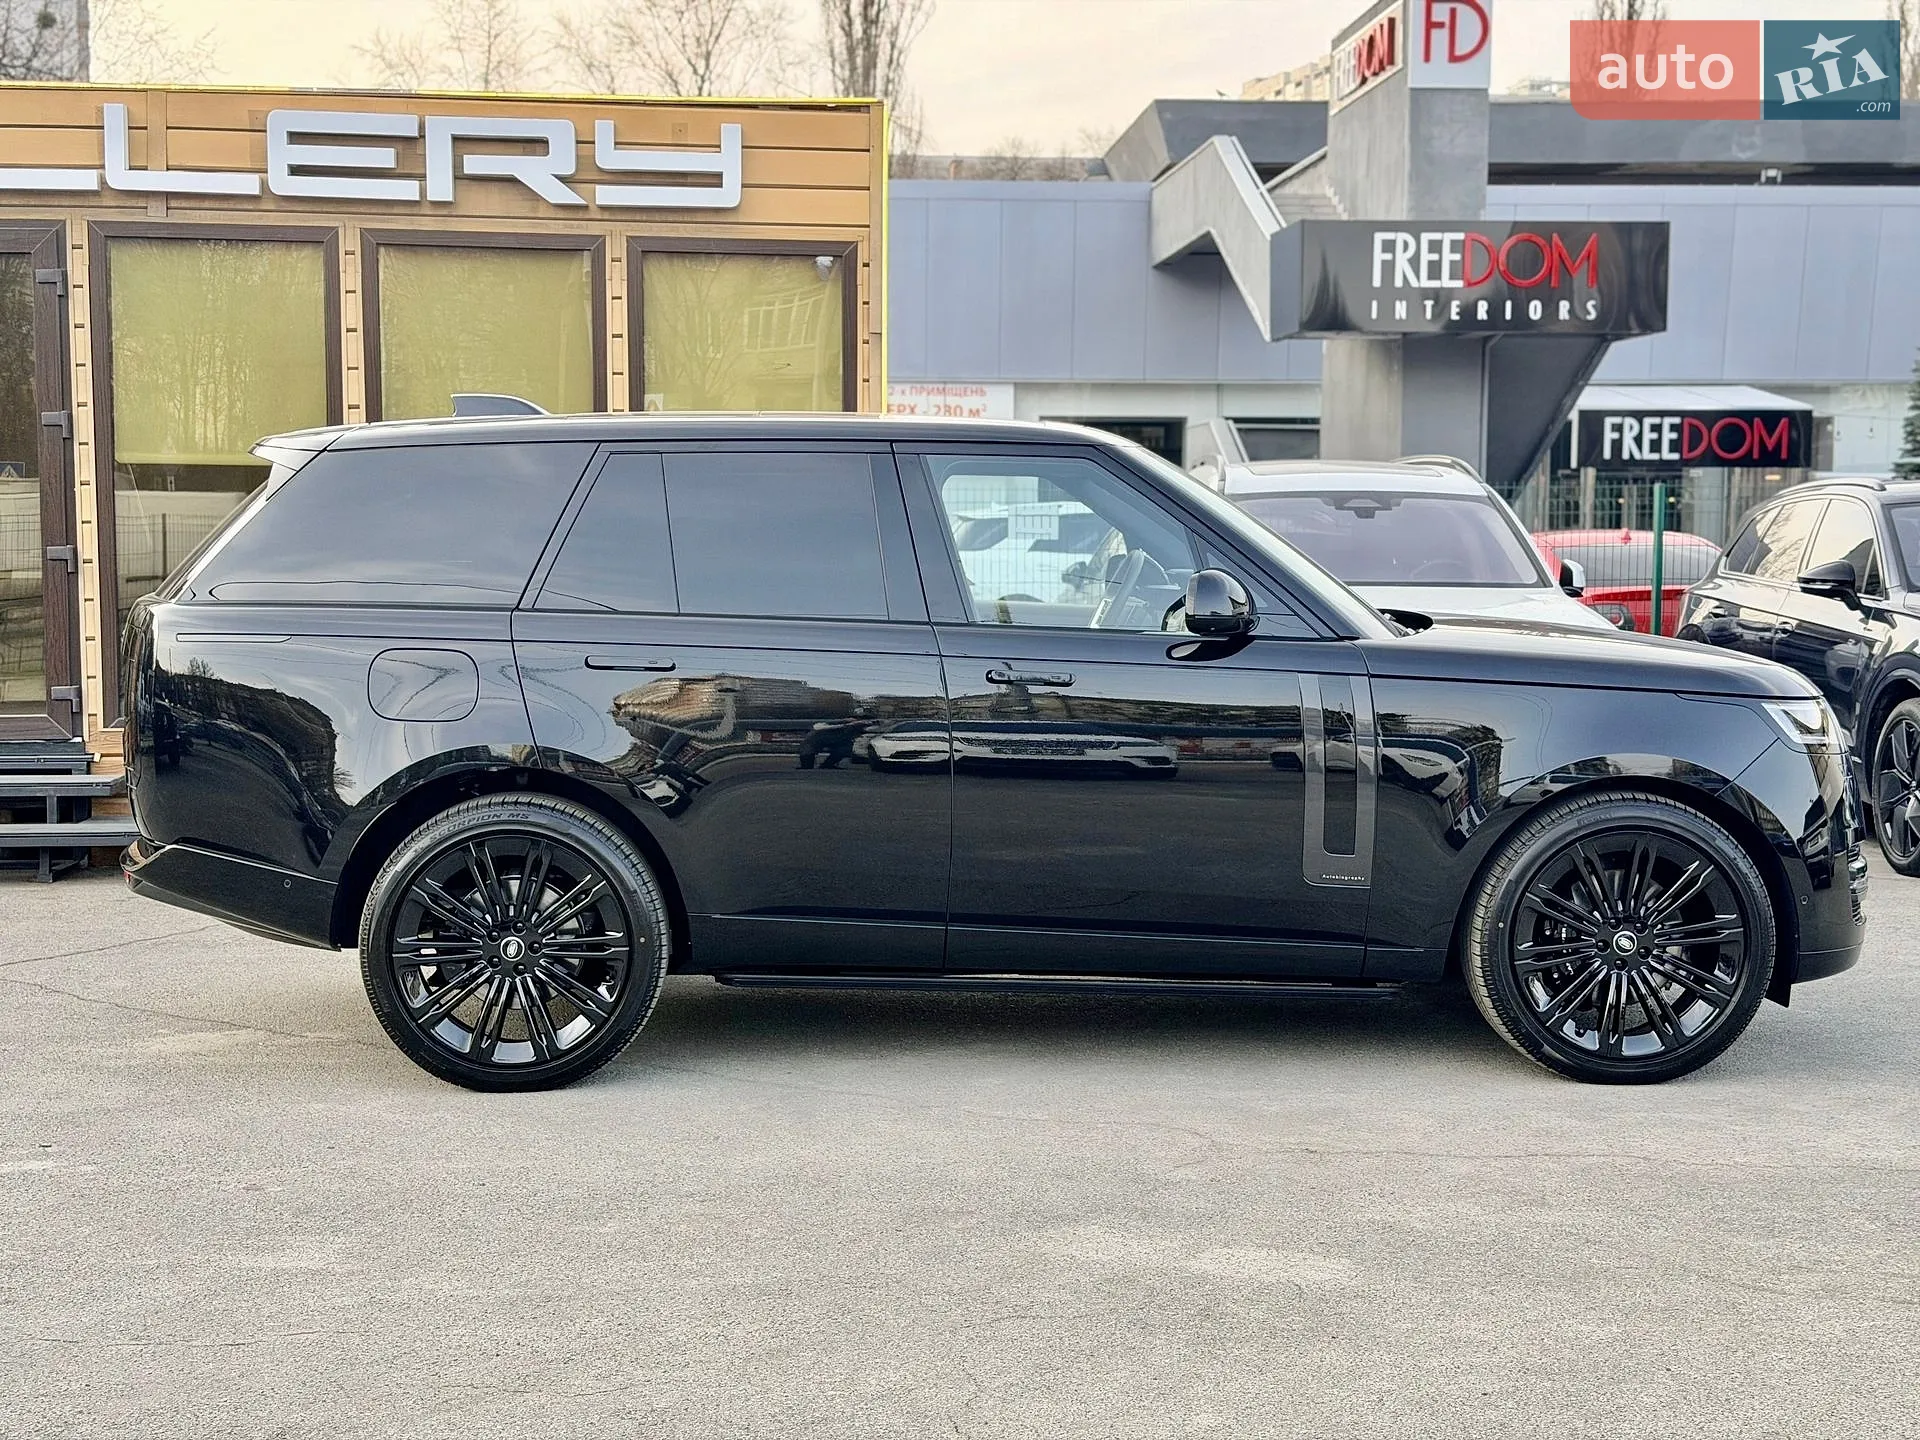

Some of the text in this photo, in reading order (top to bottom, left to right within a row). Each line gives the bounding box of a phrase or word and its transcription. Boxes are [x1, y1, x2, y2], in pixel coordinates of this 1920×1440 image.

[1423, 0, 1489, 63] FD
[1372, 232, 1598, 288] FREEDOM
[1370, 300, 1598, 320] INTERIORS
[910, 385, 987, 398] ПРИМІЩЕНЬ
[1602, 416, 1791, 461] FREEDOM
[429, 812, 503, 841] SCORPION
